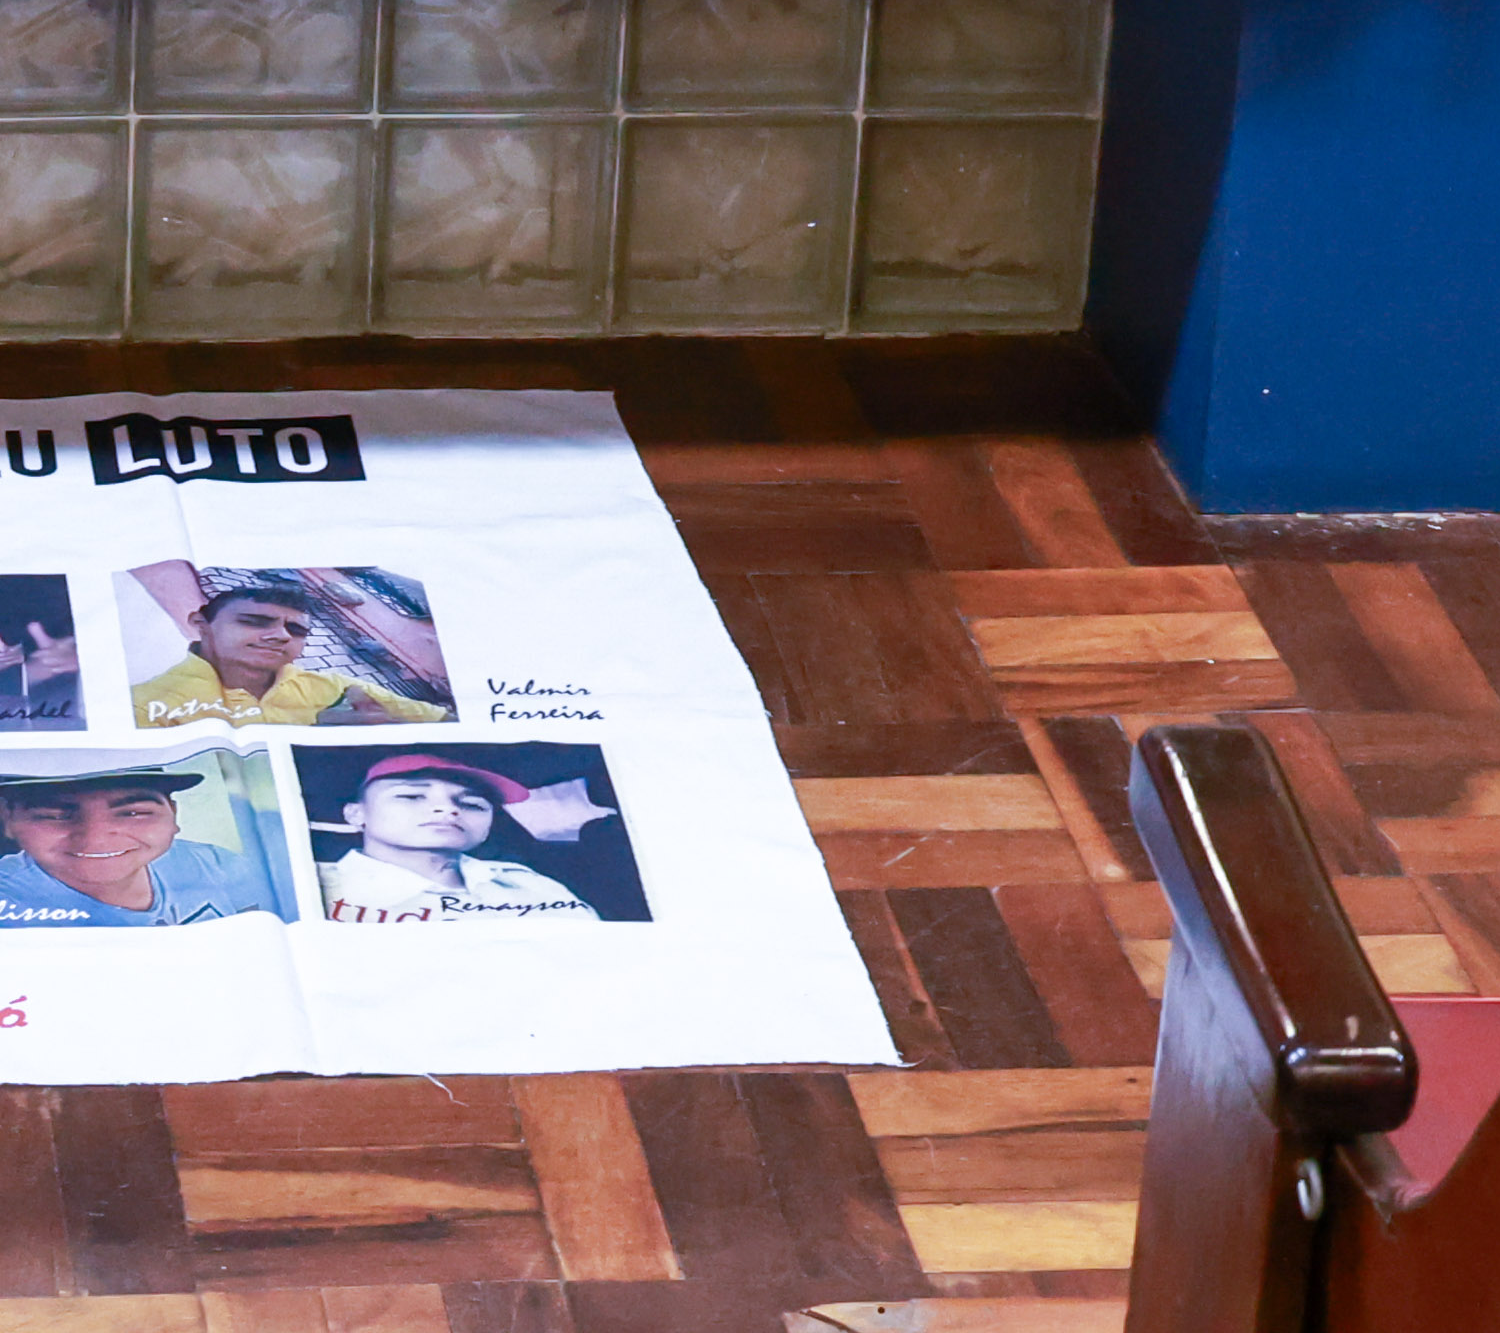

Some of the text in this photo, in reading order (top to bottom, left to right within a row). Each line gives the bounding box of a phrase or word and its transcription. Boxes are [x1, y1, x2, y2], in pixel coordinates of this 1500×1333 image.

[114, 423, 329, 475] LUTO
[490, 702, 605, 724] Ferreira
[440, 895, 590, 918] Renayson
